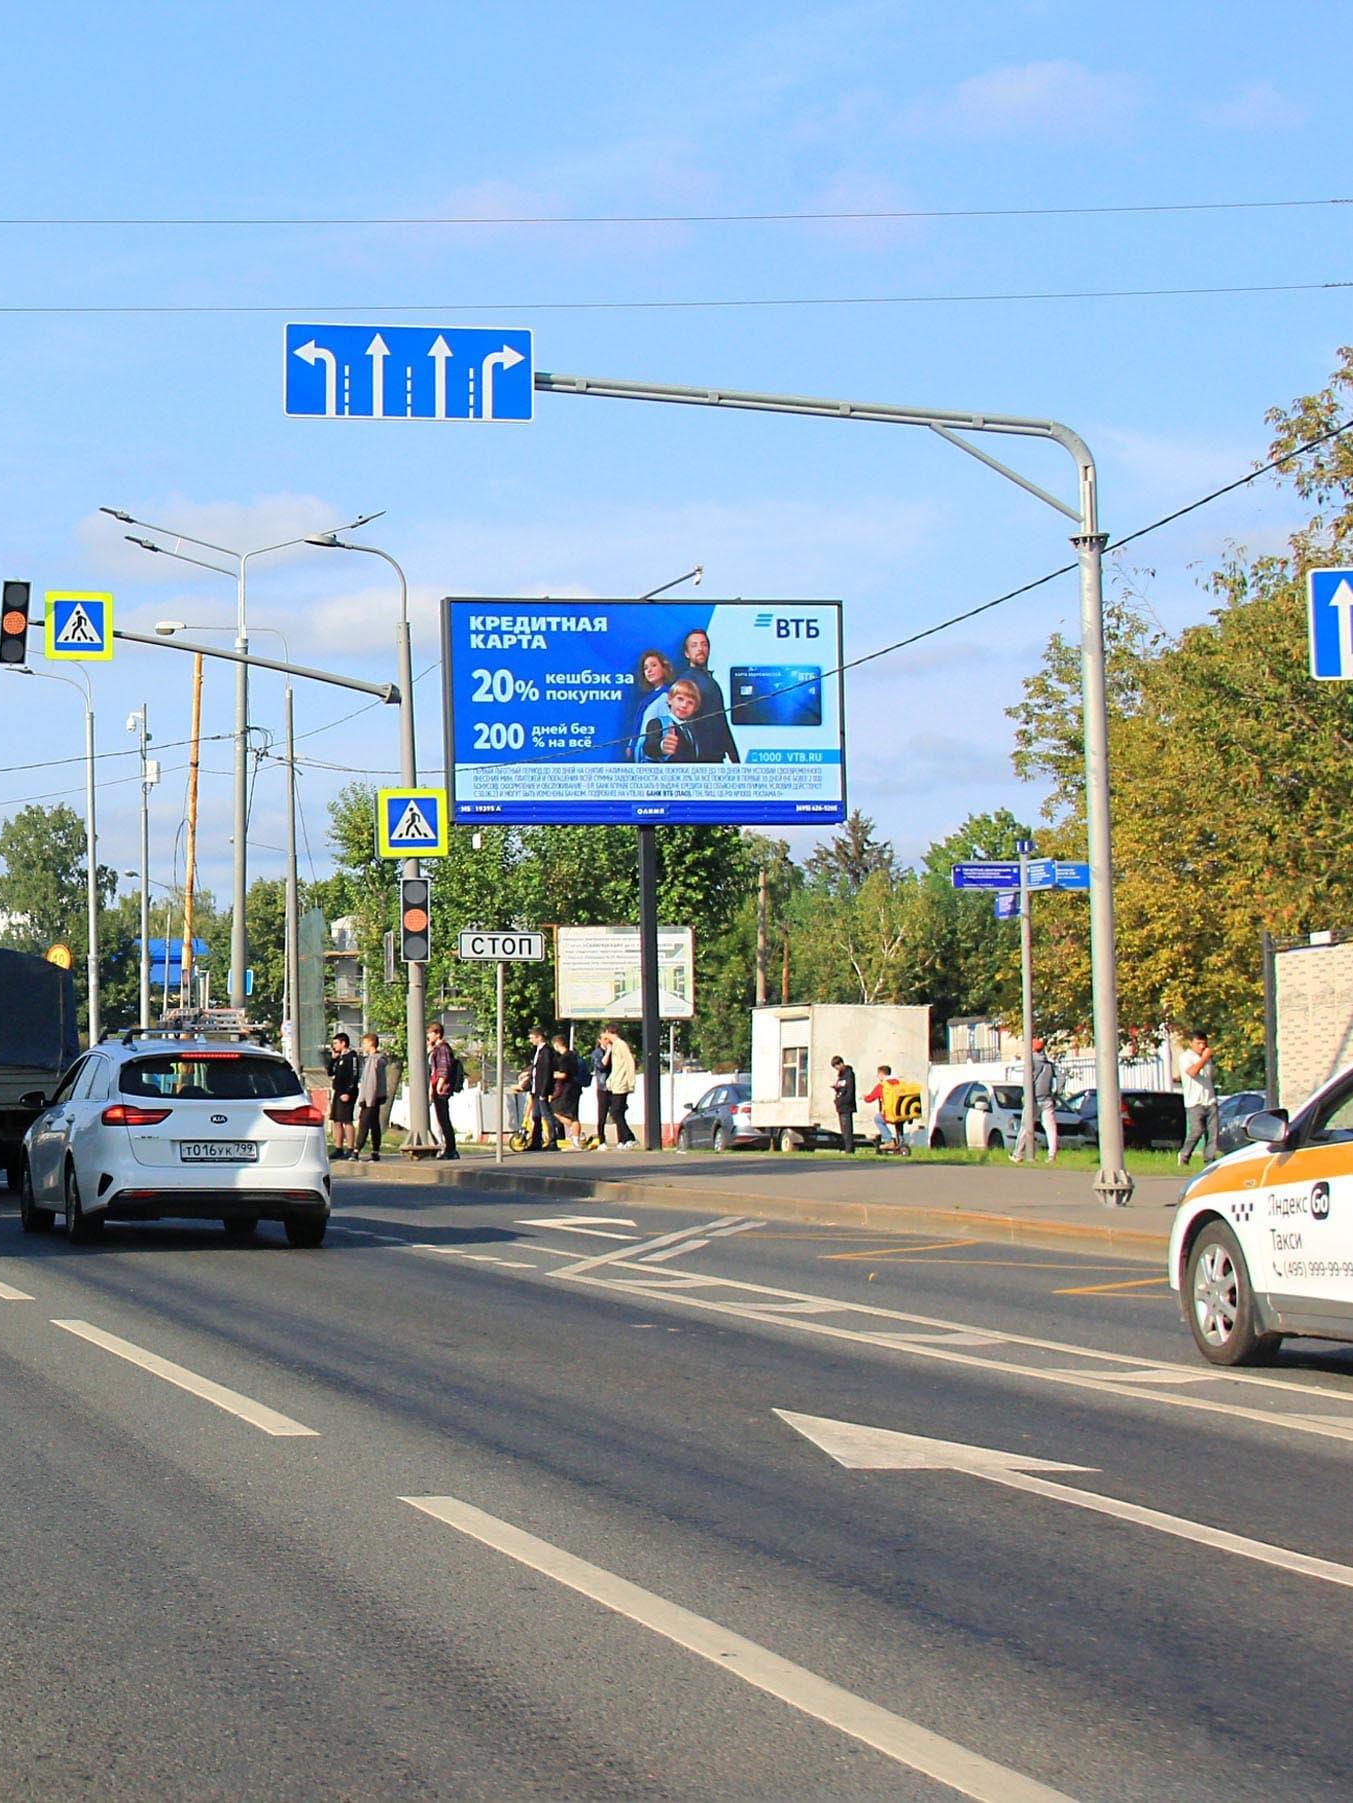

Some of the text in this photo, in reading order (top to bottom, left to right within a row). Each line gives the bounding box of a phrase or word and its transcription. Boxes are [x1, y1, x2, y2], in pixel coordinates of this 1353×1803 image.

[469, 616, 608, 633] КРЕДИТНАЯ
[776, 619, 820, 638] ВТБ
[470, 634, 547, 649] КАРТА
[471, 668, 540, 703] 20%
[545, 670, 634, 684] кешбэк за
[546, 689, 622, 704] покупки
[473, 722, 525, 749] 200
[531, 723, 595, 736] дней без
[532, 736, 592, 748] % на всё
[787, 752, 822, 761] VTB.RU
[470, 936, 532, 955] СТОП
[234, 1143, 253, 1154] 799
[1268, 1193, 1308, 1218] Яндекс
[1312, 1187, 1329, 1214] Go
[1270, 1228, 1303, 1251] Такси
[1283, 1260, 1308, 1279] (495)
